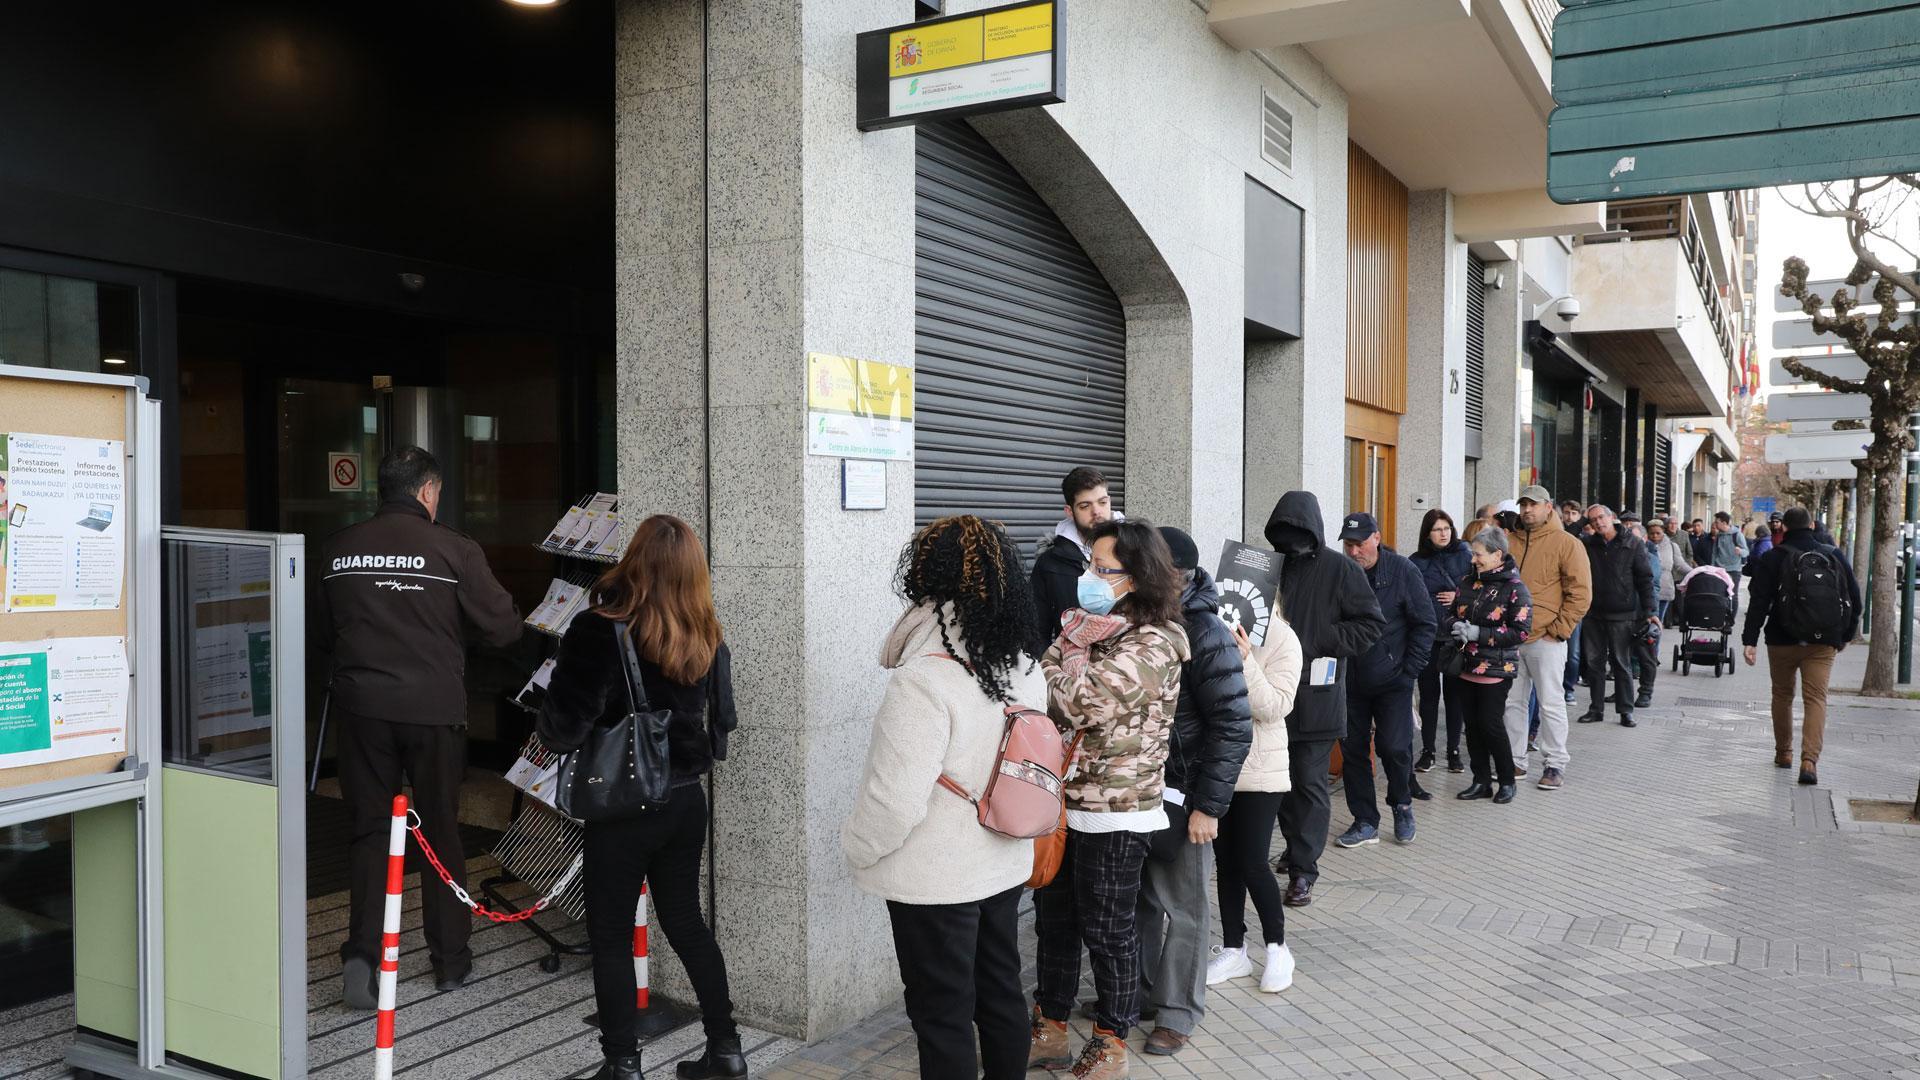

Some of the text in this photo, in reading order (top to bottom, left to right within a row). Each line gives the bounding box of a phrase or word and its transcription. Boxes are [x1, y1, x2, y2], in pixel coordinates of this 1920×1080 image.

[11, 465, 37, 474] gaineko
[77, 461, 106, 470] Informe
[74, 470, 120, 478] prestaciones
[332, 555, 425, 571] GUARDERIO
